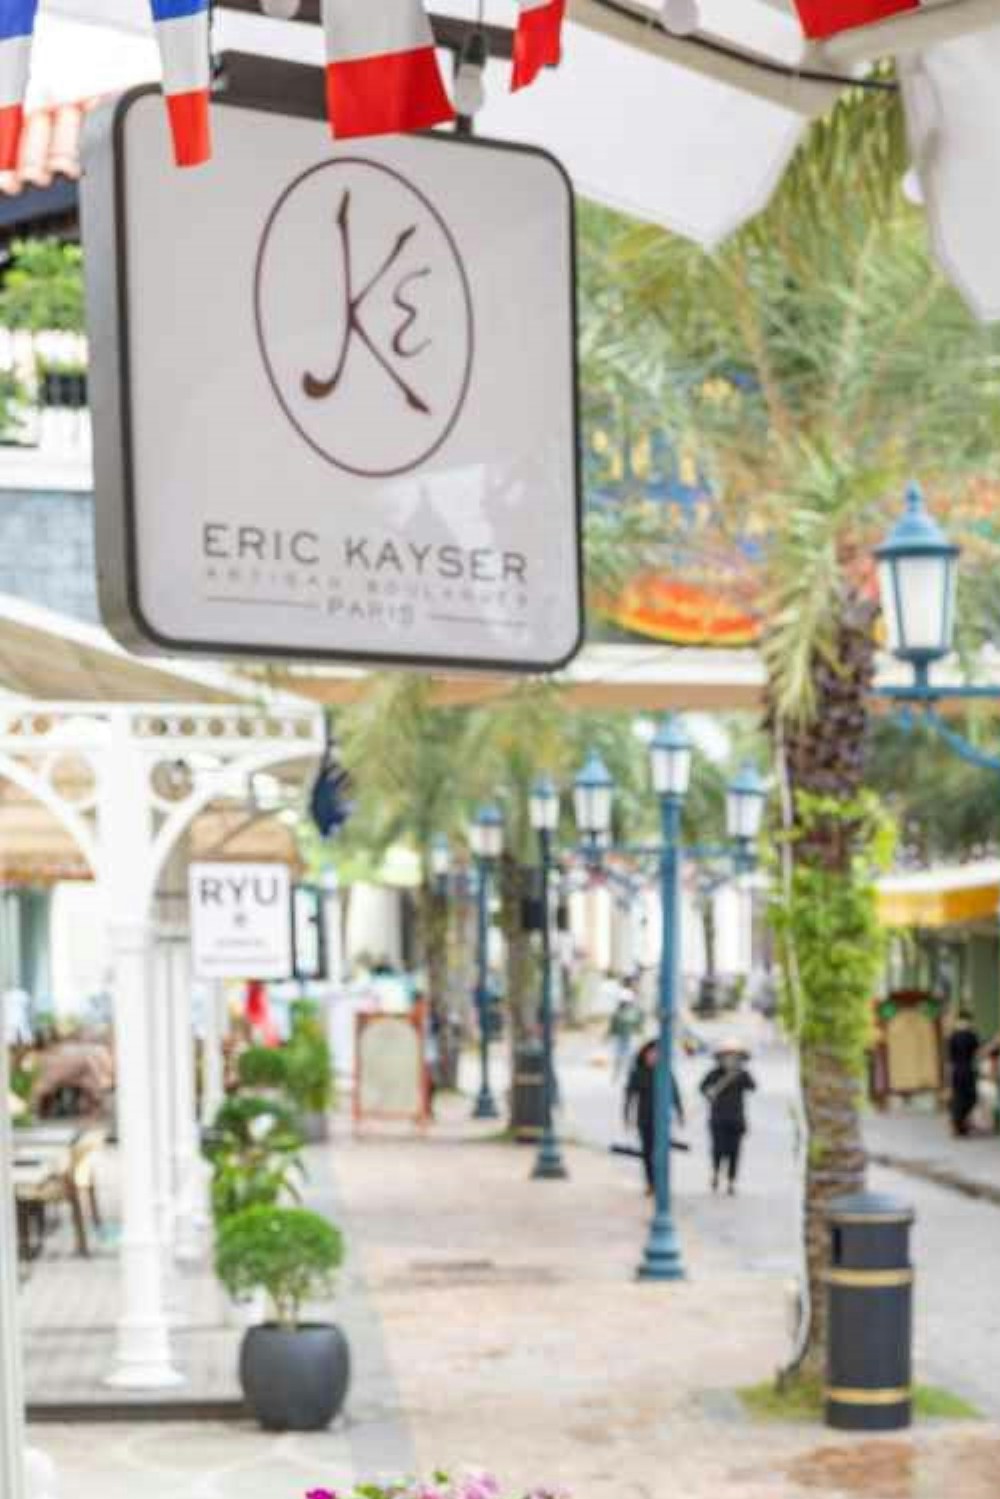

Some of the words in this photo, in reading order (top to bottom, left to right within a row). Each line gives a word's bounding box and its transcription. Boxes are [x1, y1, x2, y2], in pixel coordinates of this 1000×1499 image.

[202, 522, 321, 565] ERIC
[344, 536, 528, 583] KAYSER
[327, 597, 415, 625] PARIS
[200, 877, 279, 906] RYU
